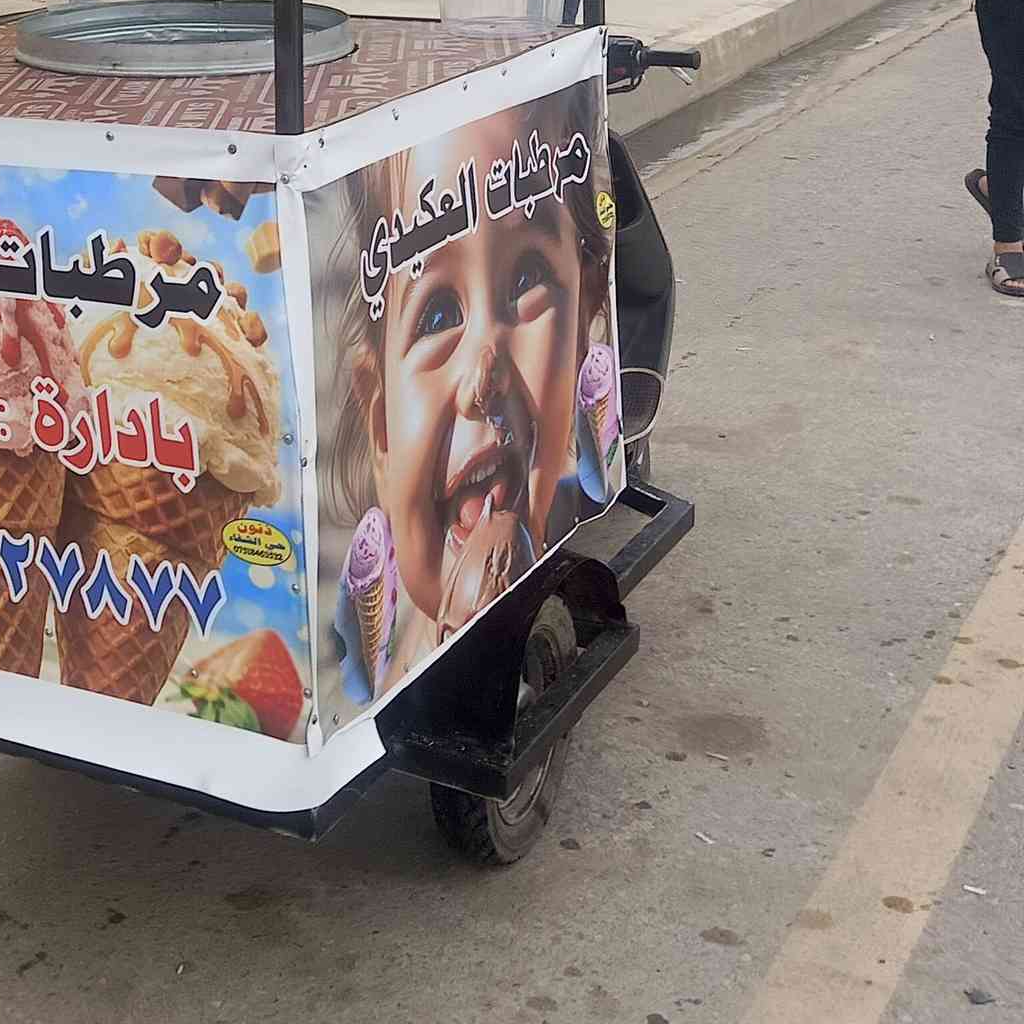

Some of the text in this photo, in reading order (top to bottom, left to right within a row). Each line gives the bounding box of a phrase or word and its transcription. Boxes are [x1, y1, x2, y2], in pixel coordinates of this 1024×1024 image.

[361, 130, 590, 320] مرطبات العكيدي
[32, 379, 198, 491] بادارة
